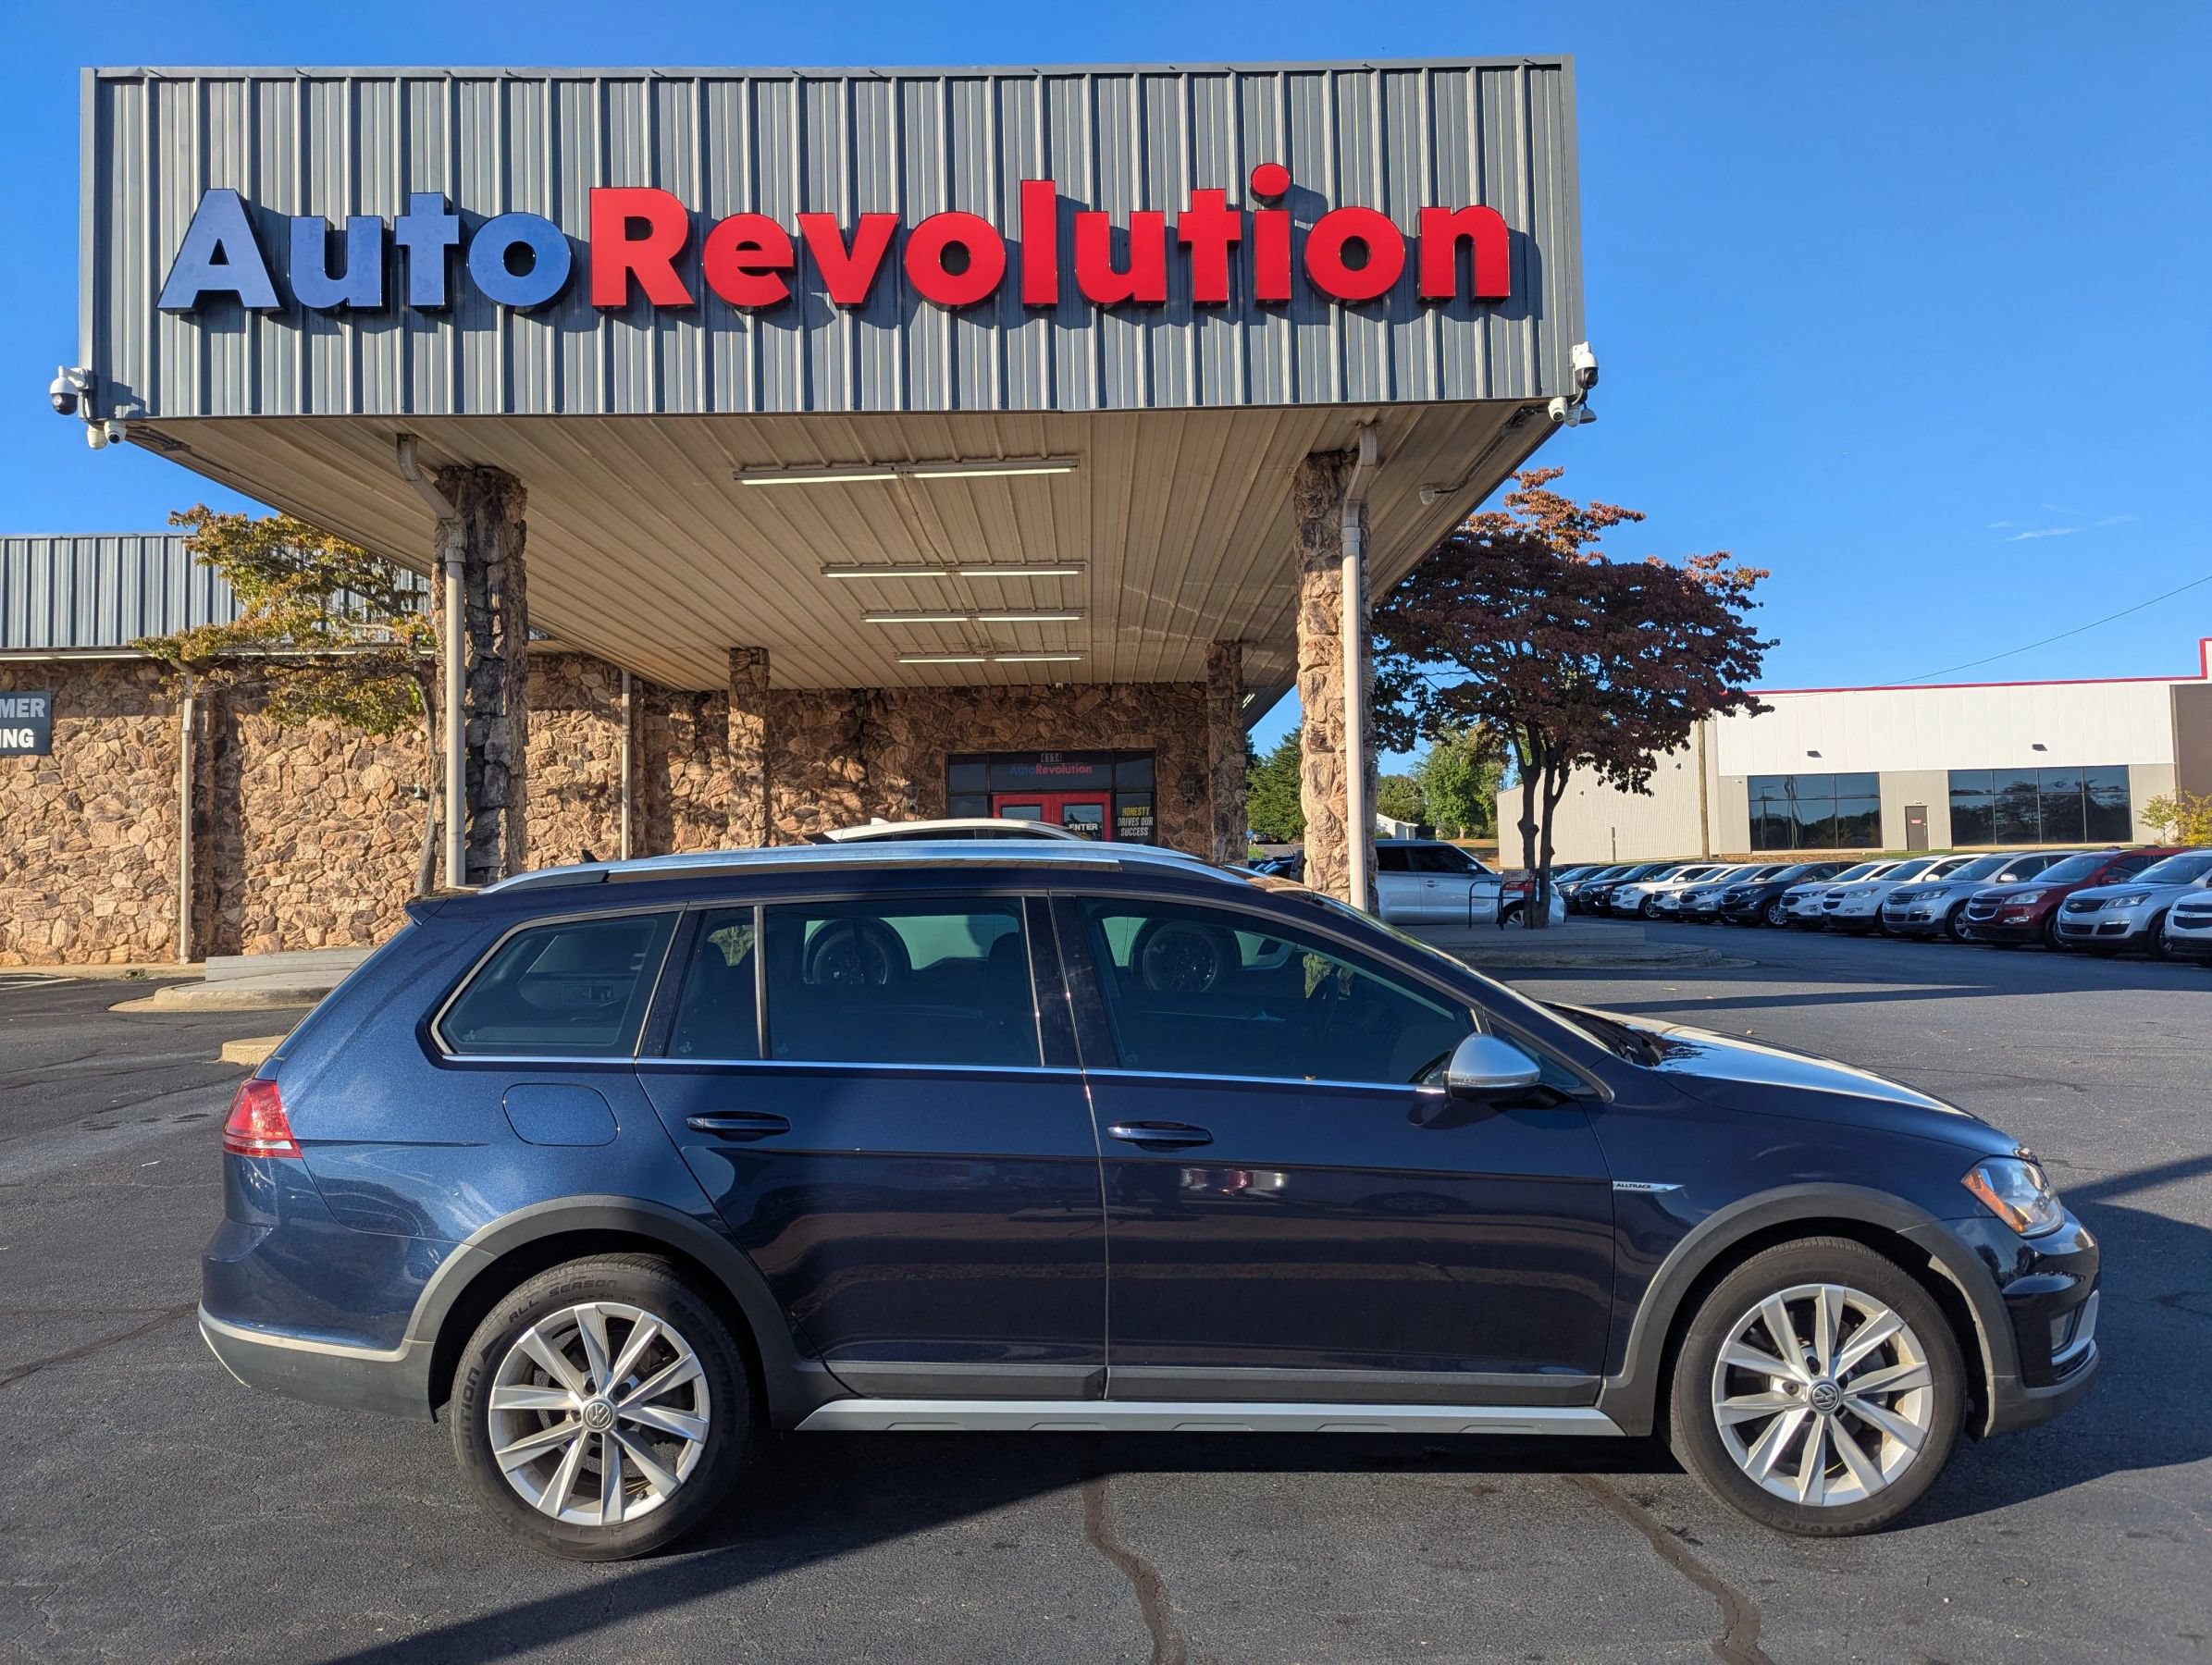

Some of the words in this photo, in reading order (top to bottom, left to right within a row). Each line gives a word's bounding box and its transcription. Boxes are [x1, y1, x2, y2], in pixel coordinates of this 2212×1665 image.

[155, 162, 1513, 312] AutoRevolution
[0, 728, 34, 748] NG
[1009, 763, 1093, 776] AutoRevolution
[1122, 807, 1150, 816] HONESTY
[1118, 817, 1139, 826] DRIVES
[1141, 817, 1154, 826] OUR
[1120, 827, 1149, 836] SUCCESS
[508, 1300, 539, 1323] ALL
[549, 1279, 619, 1297] SEASON
